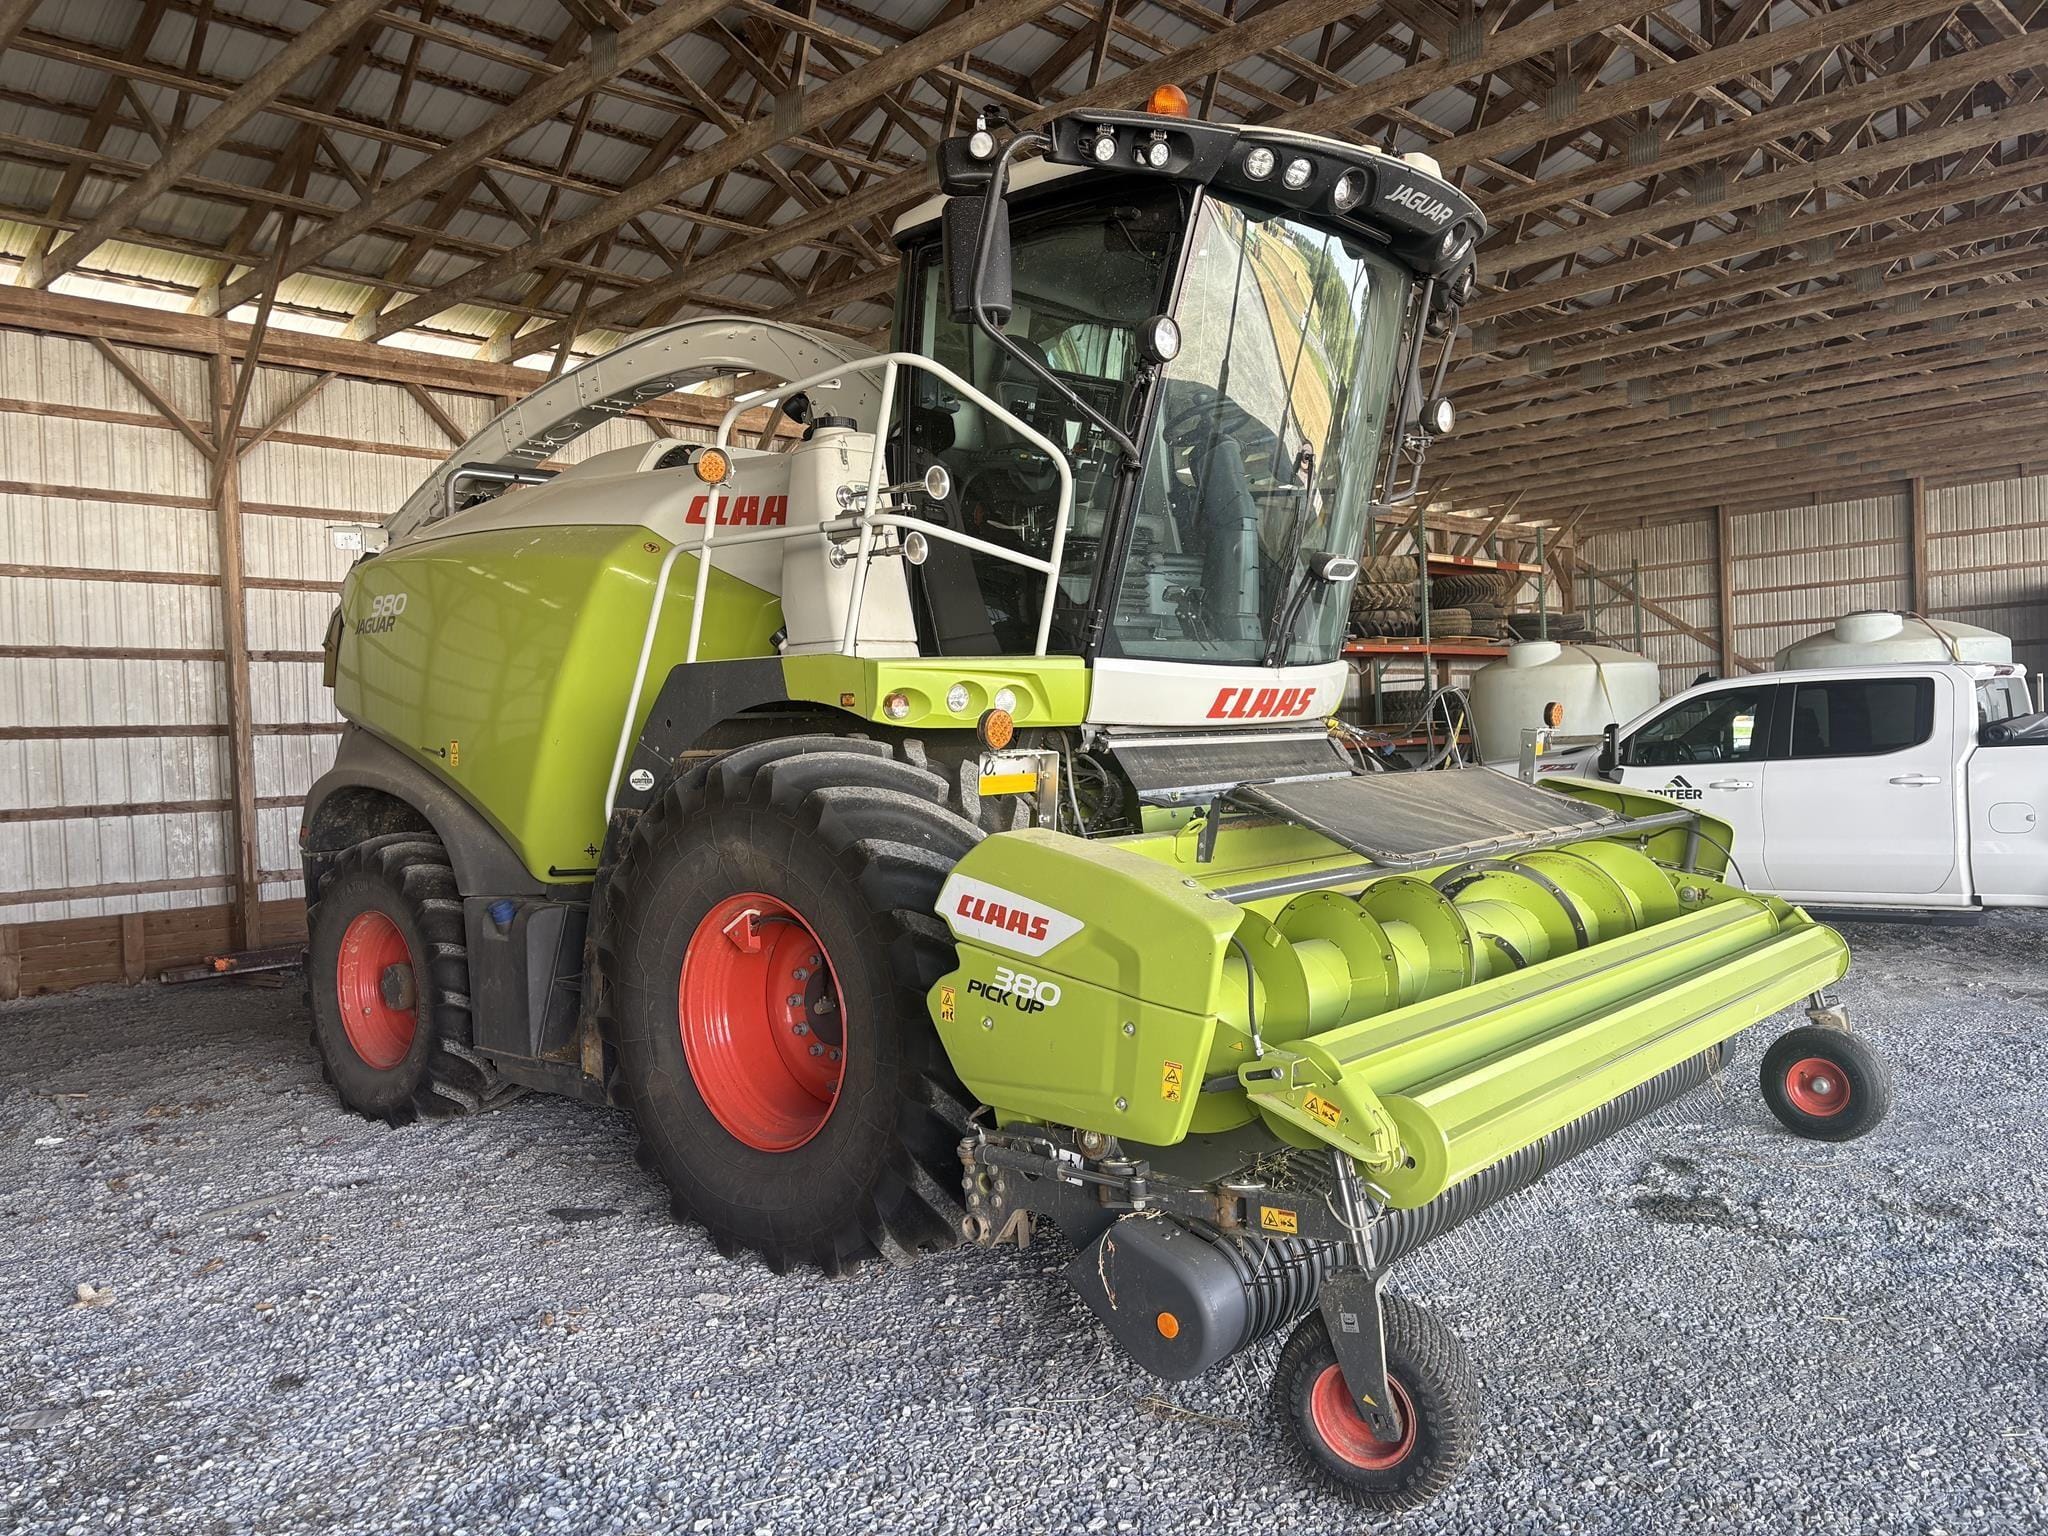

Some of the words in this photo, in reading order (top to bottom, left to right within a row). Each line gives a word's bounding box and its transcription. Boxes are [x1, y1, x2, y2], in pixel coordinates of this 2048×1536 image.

[1384, 184, 1454, 225] JAGUAR
[685, 495, 788, 526] CLAA
[371, 593, 408, 618] 980
[355, 615, 396, 635] JAGUAR
[1206, 688, 1316, 718] CLAAS
[956, 894, 1049, 941] CLAAS
[967, 979, 1012, 1006] PICK
[1015, 995, 1045, 1014] UP
[992, 966, 1061, 1007] 380
